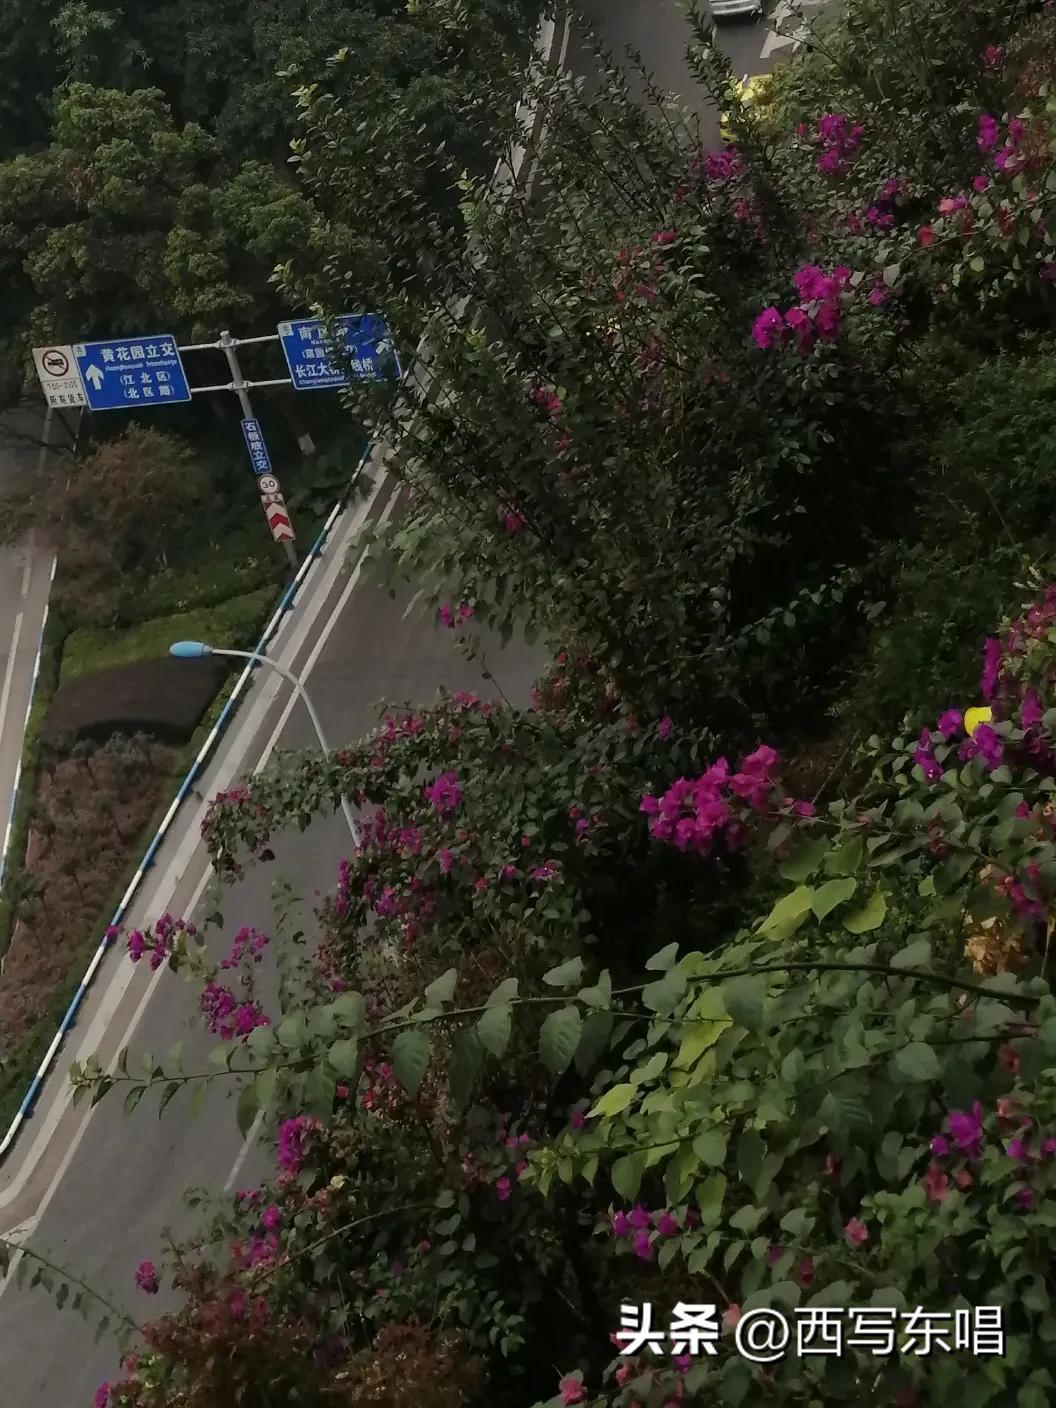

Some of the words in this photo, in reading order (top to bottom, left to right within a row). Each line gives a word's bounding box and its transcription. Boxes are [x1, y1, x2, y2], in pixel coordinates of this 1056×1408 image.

[100, 342, 176, 363] 黄花园立交
[261, 480, 276, 489] 30
